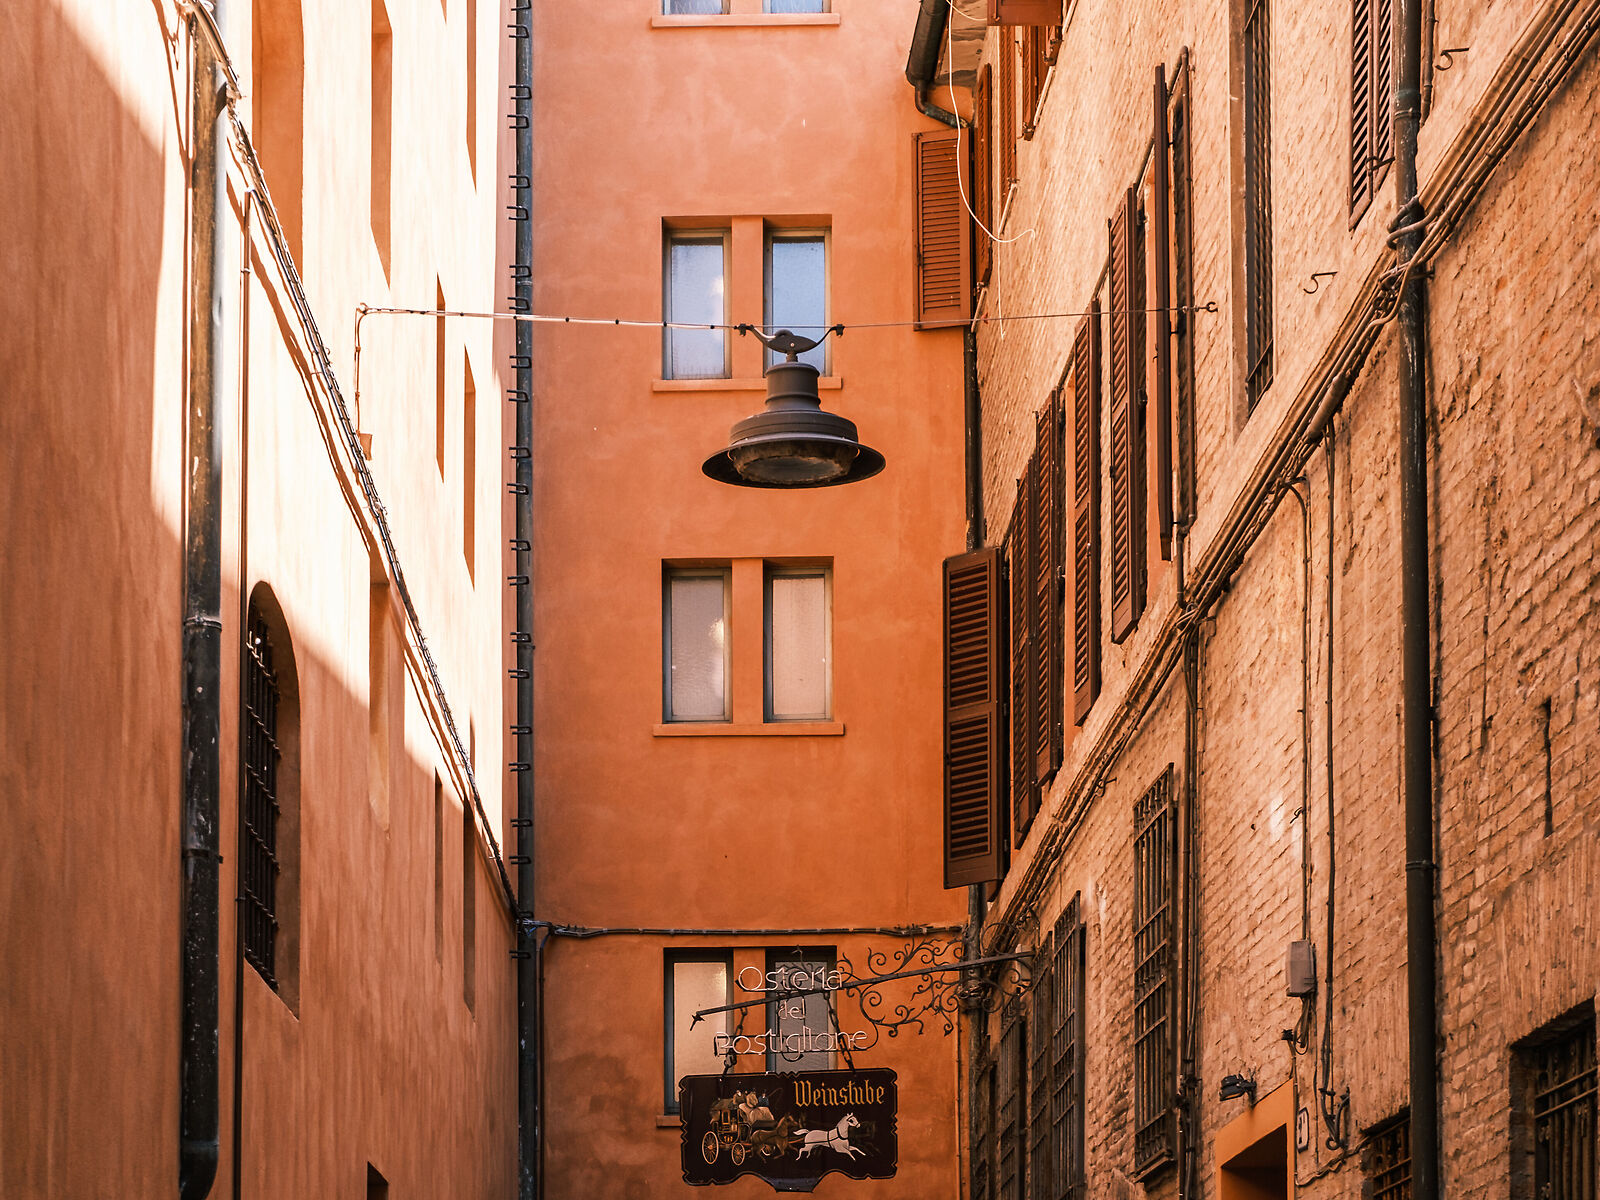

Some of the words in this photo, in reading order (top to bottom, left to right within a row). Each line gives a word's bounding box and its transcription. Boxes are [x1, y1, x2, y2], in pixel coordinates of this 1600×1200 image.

[738, 966, 843, 991] Osteria
[778, 998, 806, 1020] del
[714, 1025, 868, 1062] Postiglione
[794, 1080, 884, 1107] Weinstube
